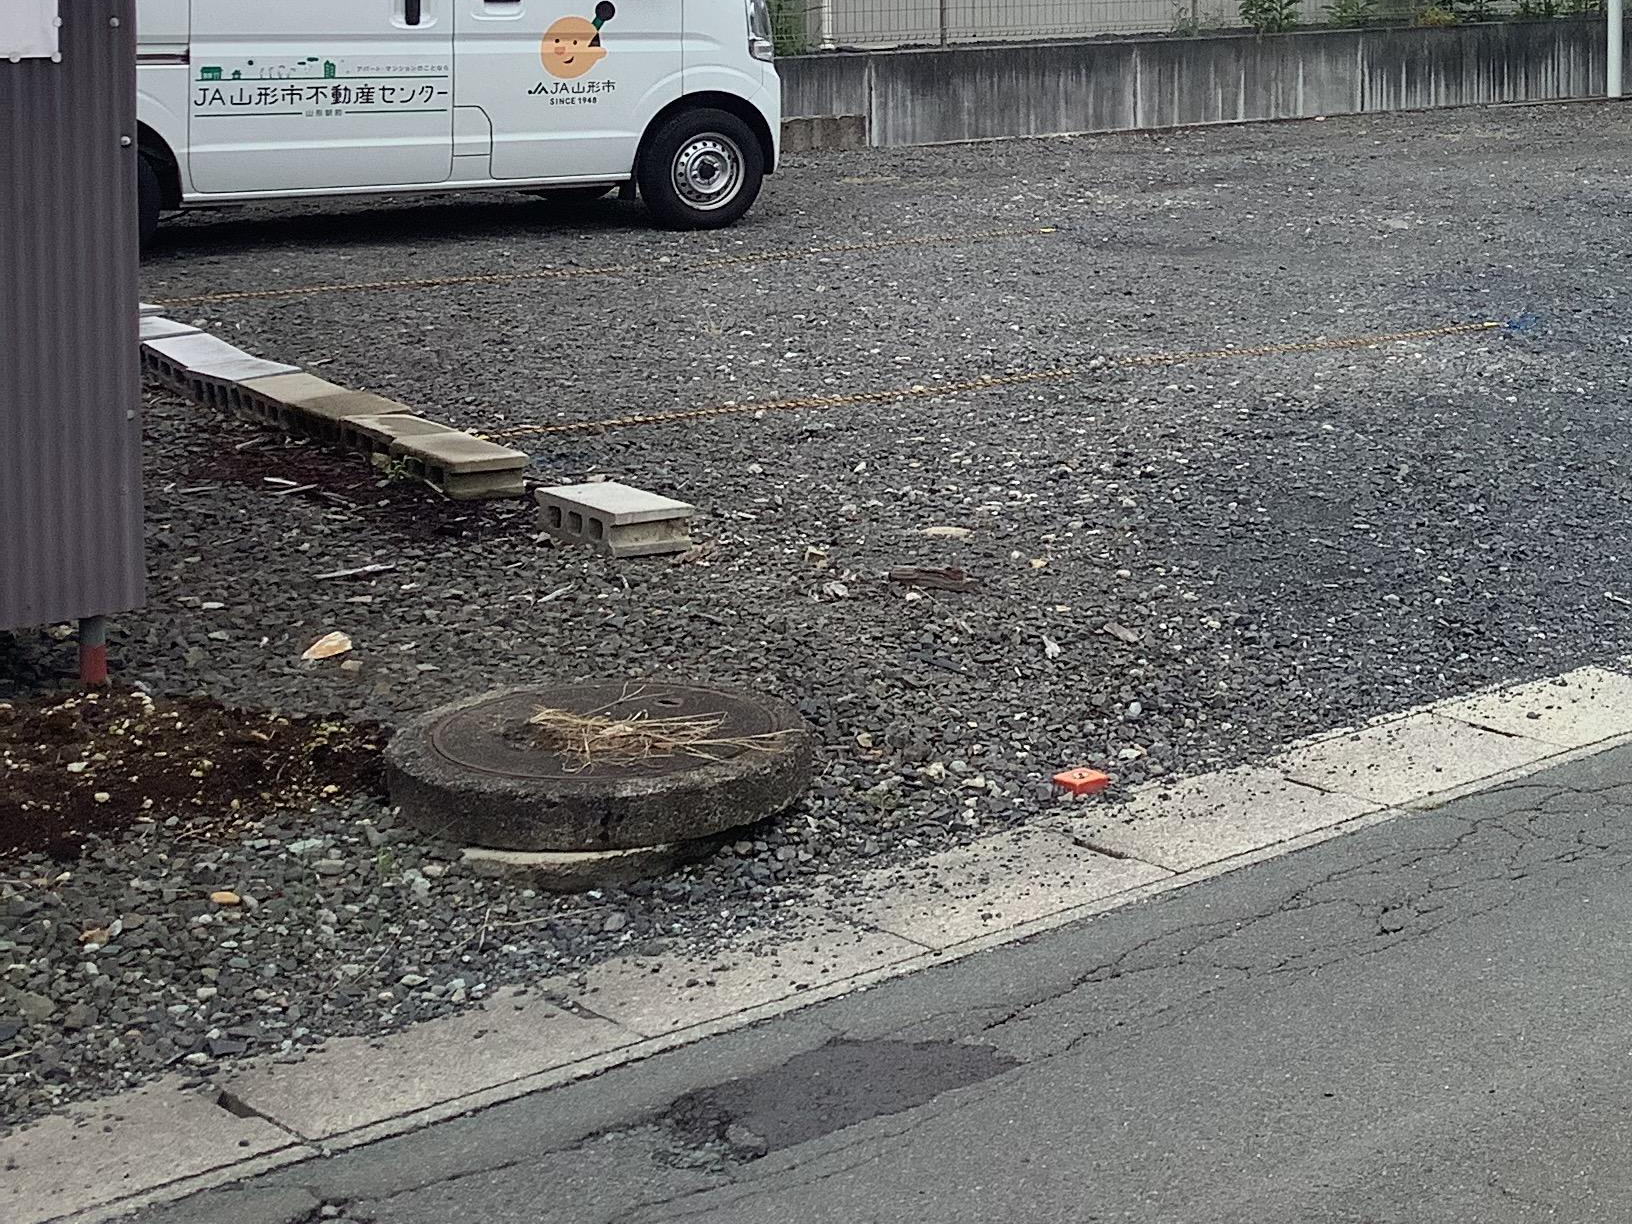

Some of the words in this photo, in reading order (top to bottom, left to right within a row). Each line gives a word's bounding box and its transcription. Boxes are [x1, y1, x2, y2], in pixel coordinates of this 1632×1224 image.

[550, 80, 616, 95] JA山形市
[194, 84, 448, 107] JA山形市不動産センター
[550, 97, 576, 106] SINCE
